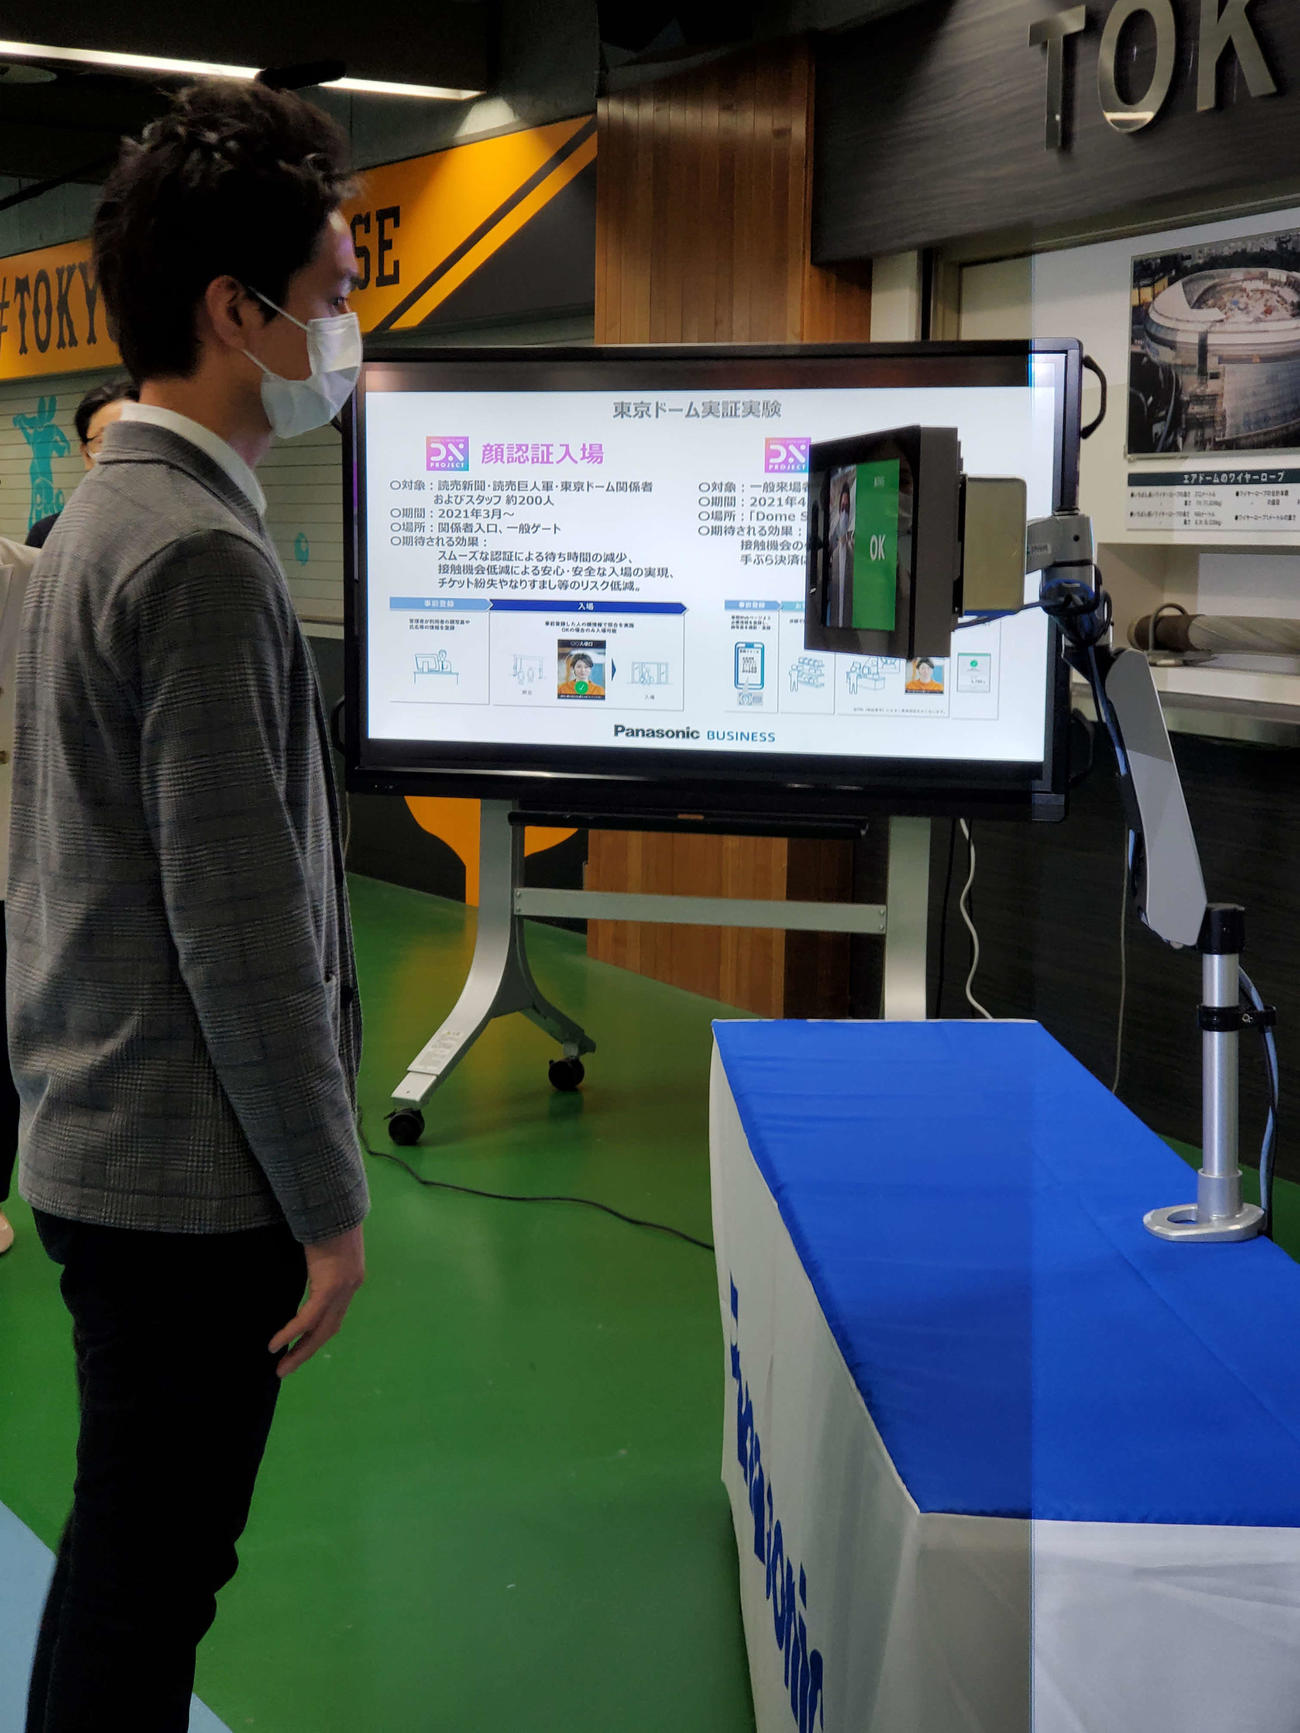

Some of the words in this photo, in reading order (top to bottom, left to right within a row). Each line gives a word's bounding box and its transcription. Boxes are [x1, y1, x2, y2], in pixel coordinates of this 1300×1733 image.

[1028, 0, 1278, 151] TOK
[613, 400, 781, 419] 東京ドーム実証実験
[481, 443, 604, 464] 顔認証入場
[741, 539, 807, 552] 接触機会の
[869, 534, 886, 560] OK
[578, 602, 595, 611] 入場
[613, 724, 700, 739] Panasonic
[706, 730, 776, 742] BUSINESS
